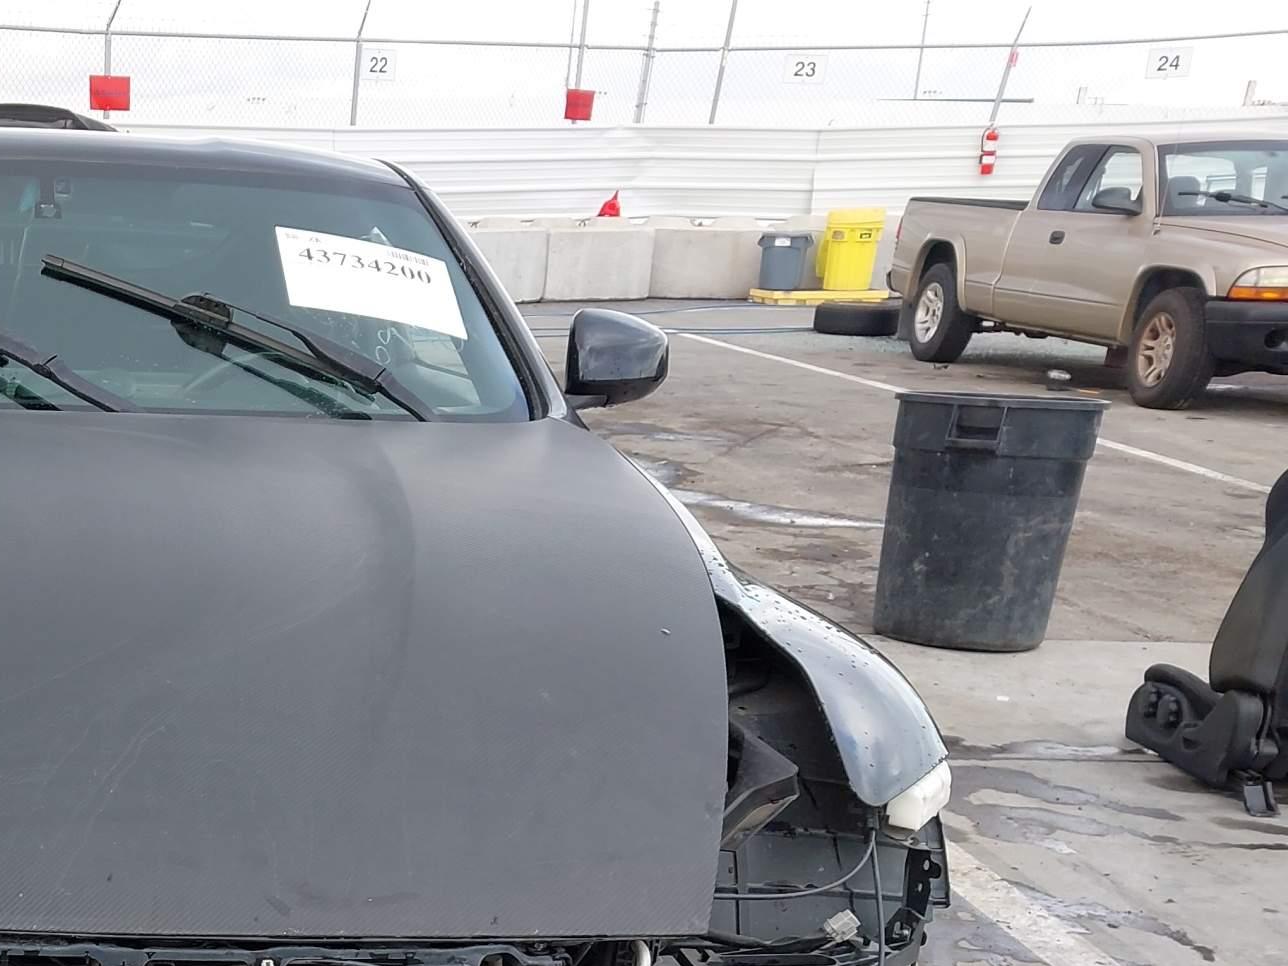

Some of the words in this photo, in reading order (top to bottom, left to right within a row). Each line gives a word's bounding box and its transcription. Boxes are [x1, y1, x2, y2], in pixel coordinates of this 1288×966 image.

[369, 56, 388, 73] 22
[793, 61, 817, 78] 23
[1156, 55, 1180, 71] 24
[298, 247, 432, 284] 43734200
